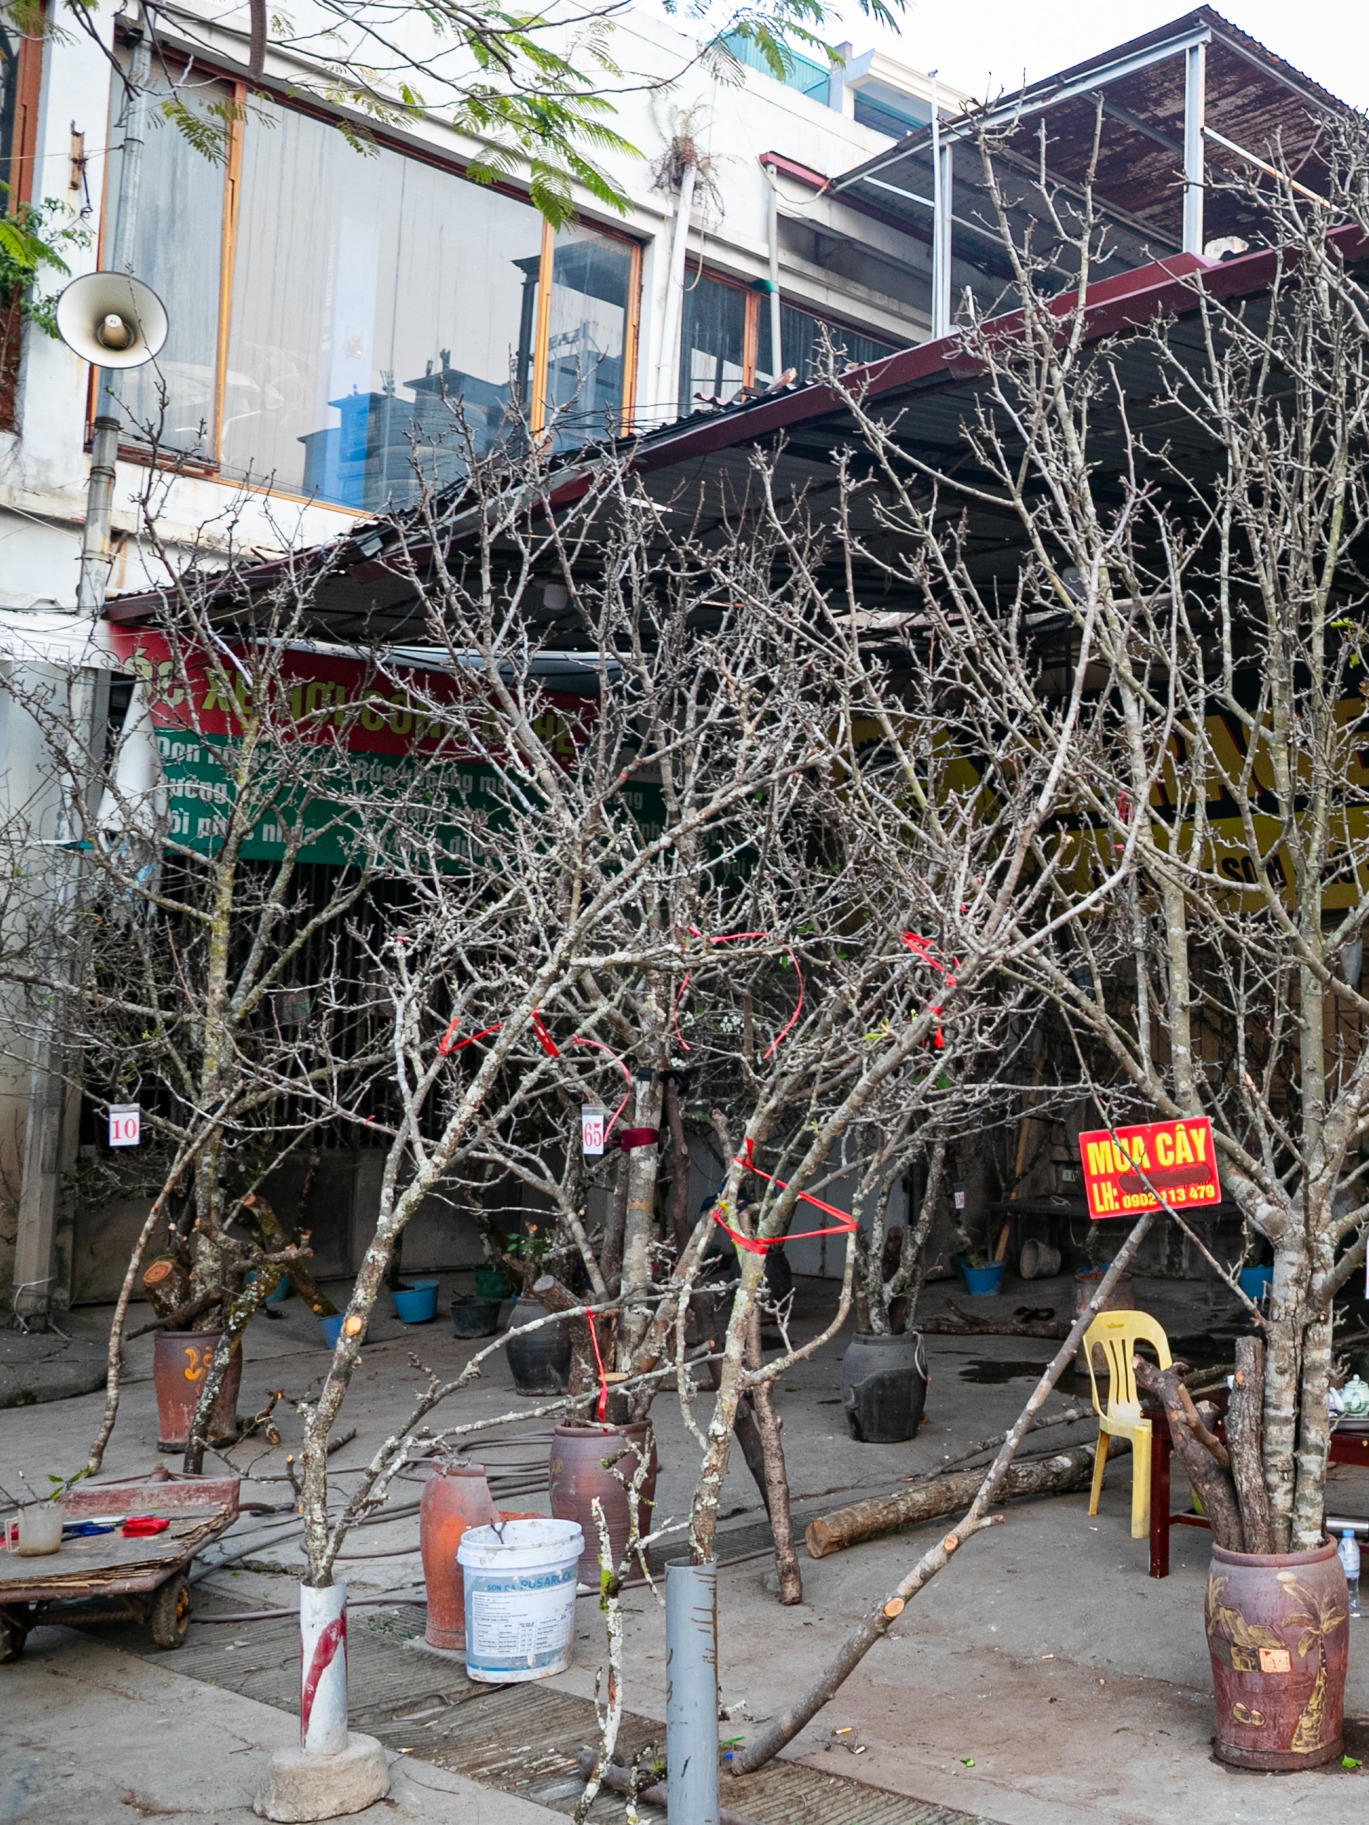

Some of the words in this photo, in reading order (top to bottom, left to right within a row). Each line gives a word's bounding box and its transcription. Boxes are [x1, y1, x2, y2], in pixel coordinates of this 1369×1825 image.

[112, 1118, 137, 1140] 10
[583, 1122, 602, 1147] 65
[1086, 1136, 1151, 1176] MUA
[1155, 1123, 1207, 1167] CÂY
[1092, 1181, 1120, 1213] LH:
[1123, 1192, 1157, 1209] 0902
[1189, 1184, 1215, 1200] 479
